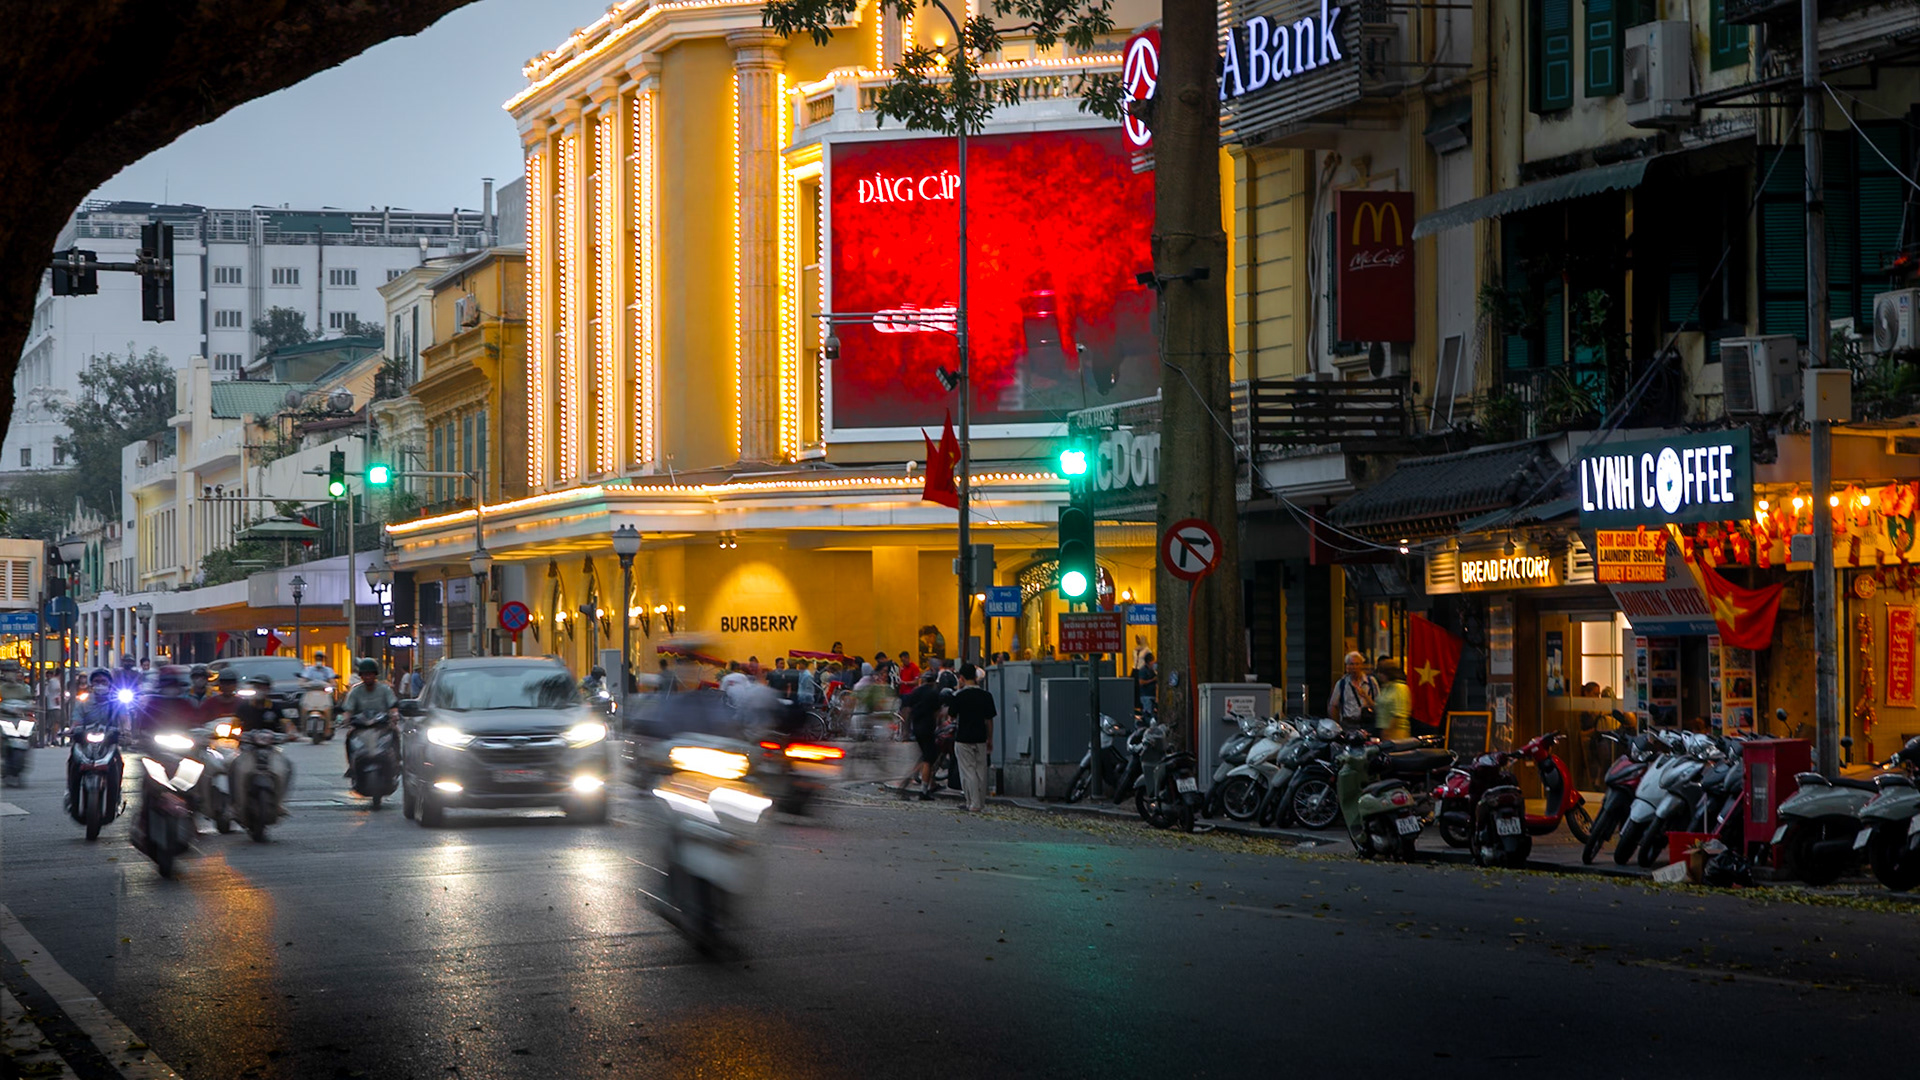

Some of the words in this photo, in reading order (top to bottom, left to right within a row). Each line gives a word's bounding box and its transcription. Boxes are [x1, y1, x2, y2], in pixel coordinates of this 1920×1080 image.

[1581, 455, 1635, 512] LYNH
[1599, 533, 1614, 547] SIM
[1616, 533, 1636, 547] CARD
[1600, 549, 1632, 562] LAUNDRY
[1461, 559, 1499, 584] BREAD
[1500, 556, 1550, 581] FACTORY
[1599, 565, 1625, 581] MONEY
[1626, 565, 1665, 581] EXCHANGE
[721, 615, 798, 633] BURBERRY
